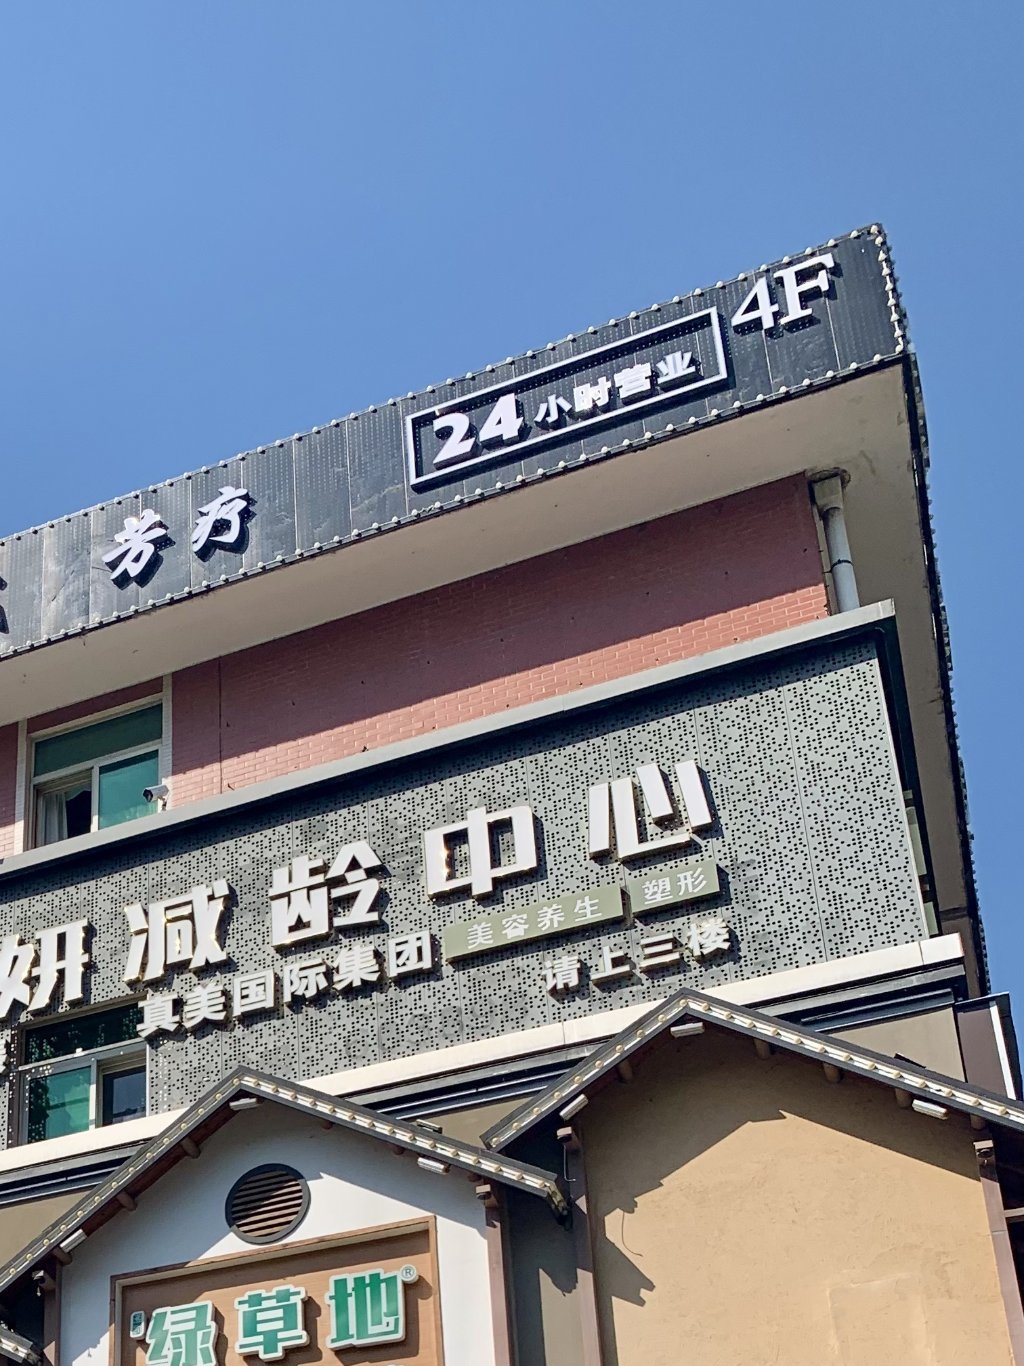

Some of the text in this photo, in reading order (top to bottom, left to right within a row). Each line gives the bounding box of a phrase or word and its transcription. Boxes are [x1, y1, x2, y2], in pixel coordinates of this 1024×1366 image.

[732, 253, 836, 331] 4F
[433, 348, 698, 467] 24小时营业
[102, 485, 257, 590] 芳疗
[465, 867, 708, 950] 美容养生 塑形
[543, 916, 732, 995] 请上三楼
[136, 930, 434, 1038] 真美国际集团
